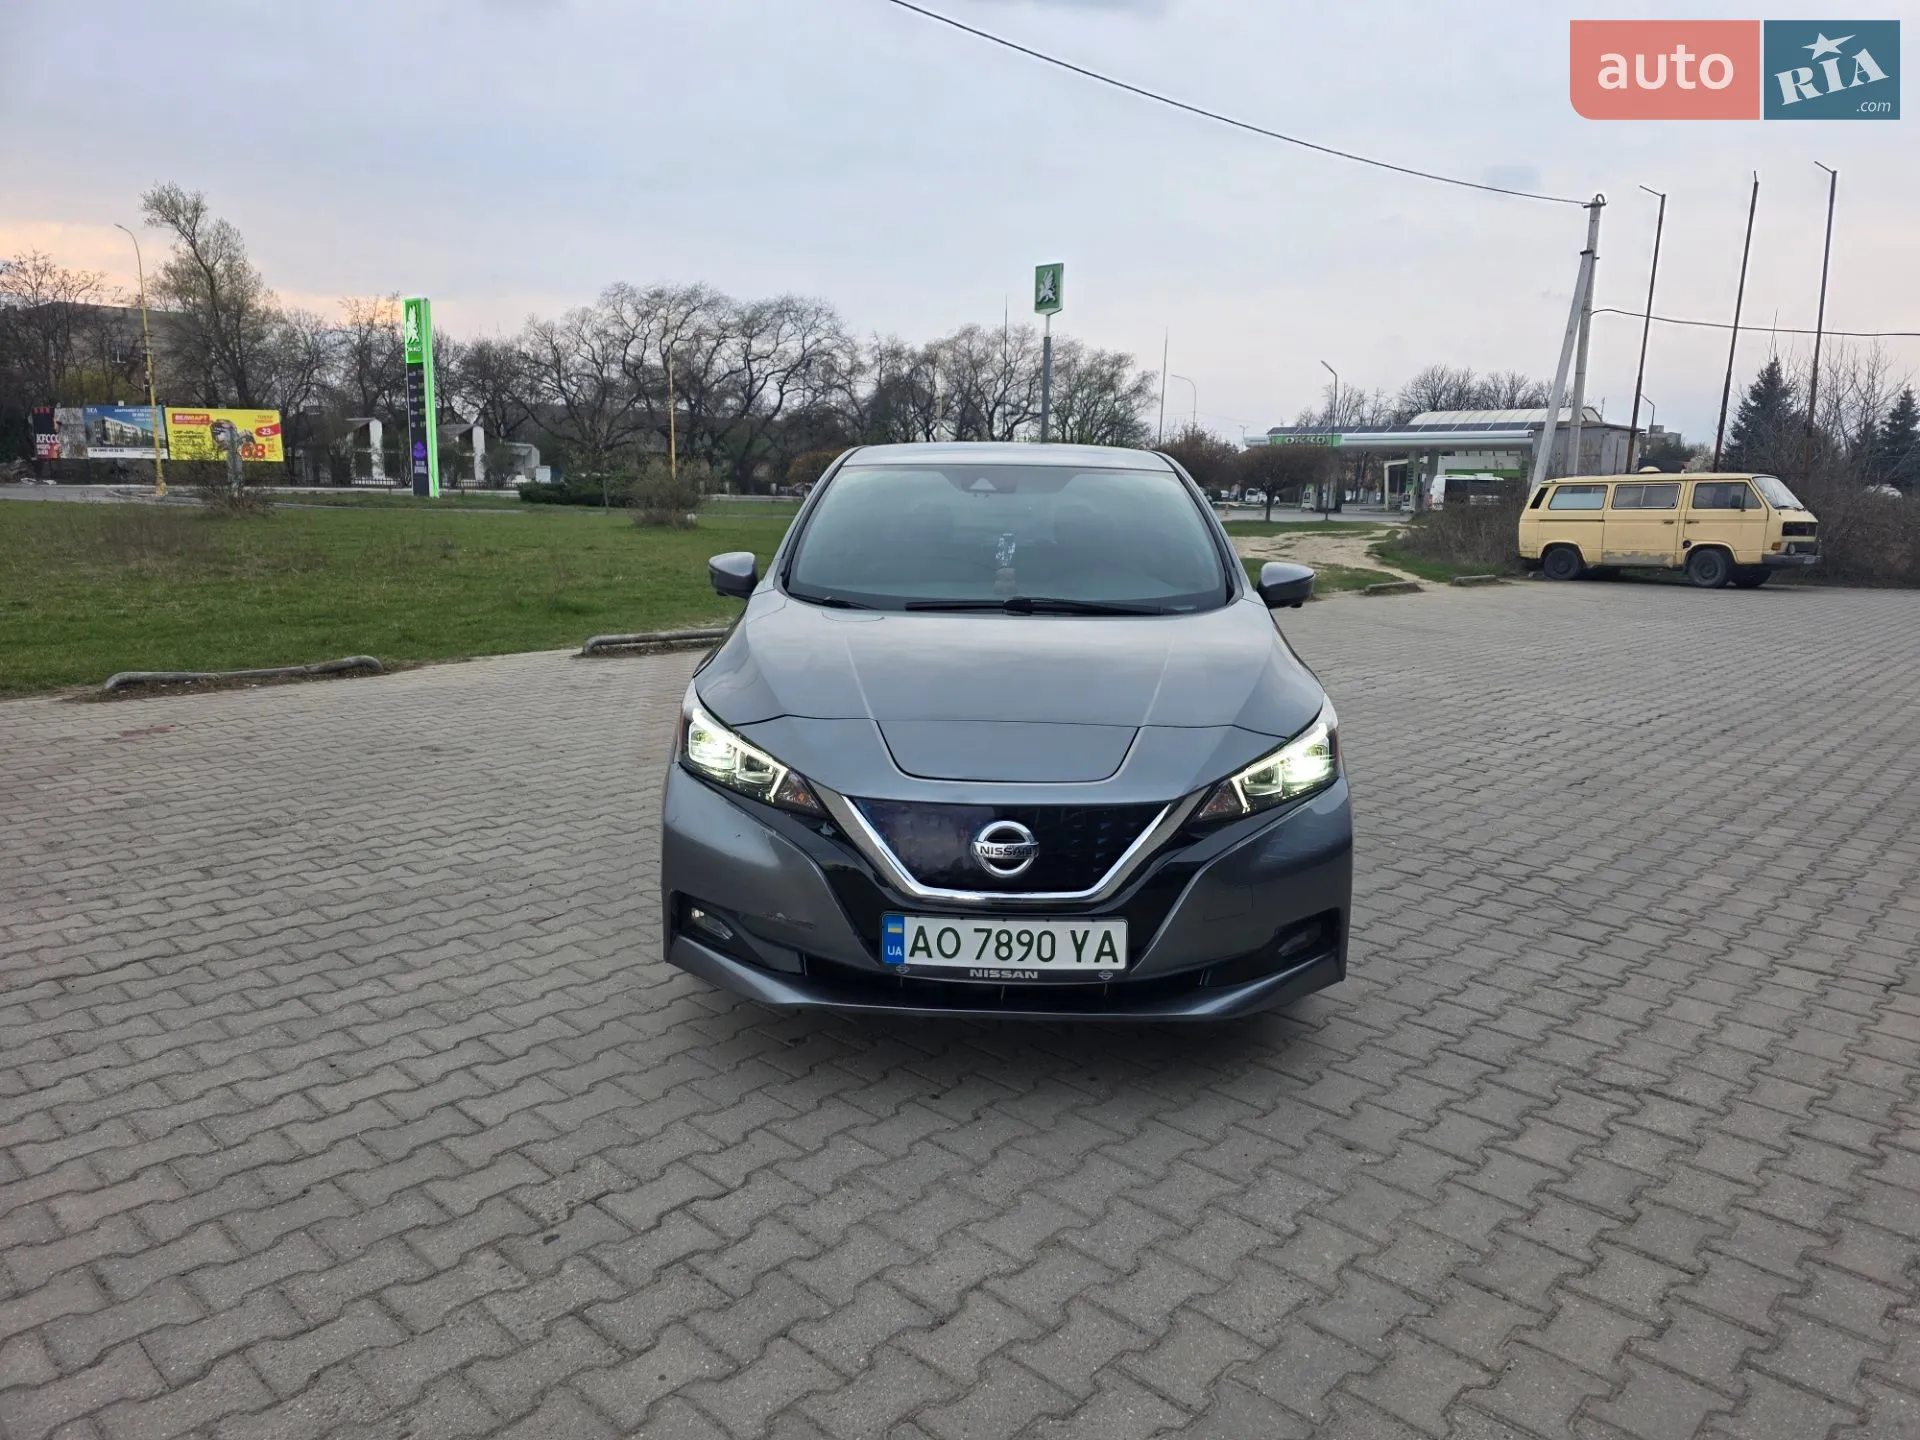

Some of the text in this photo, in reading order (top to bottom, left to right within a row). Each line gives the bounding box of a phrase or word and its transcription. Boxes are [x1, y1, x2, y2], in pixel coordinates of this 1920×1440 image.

[980, 845, 1035, 857] NISSAN
[908, 925, 1119, 964] AO 7890 YA
[887, 946, 903, 956] UA
[969, 968, 1038, 980] NISSAN
